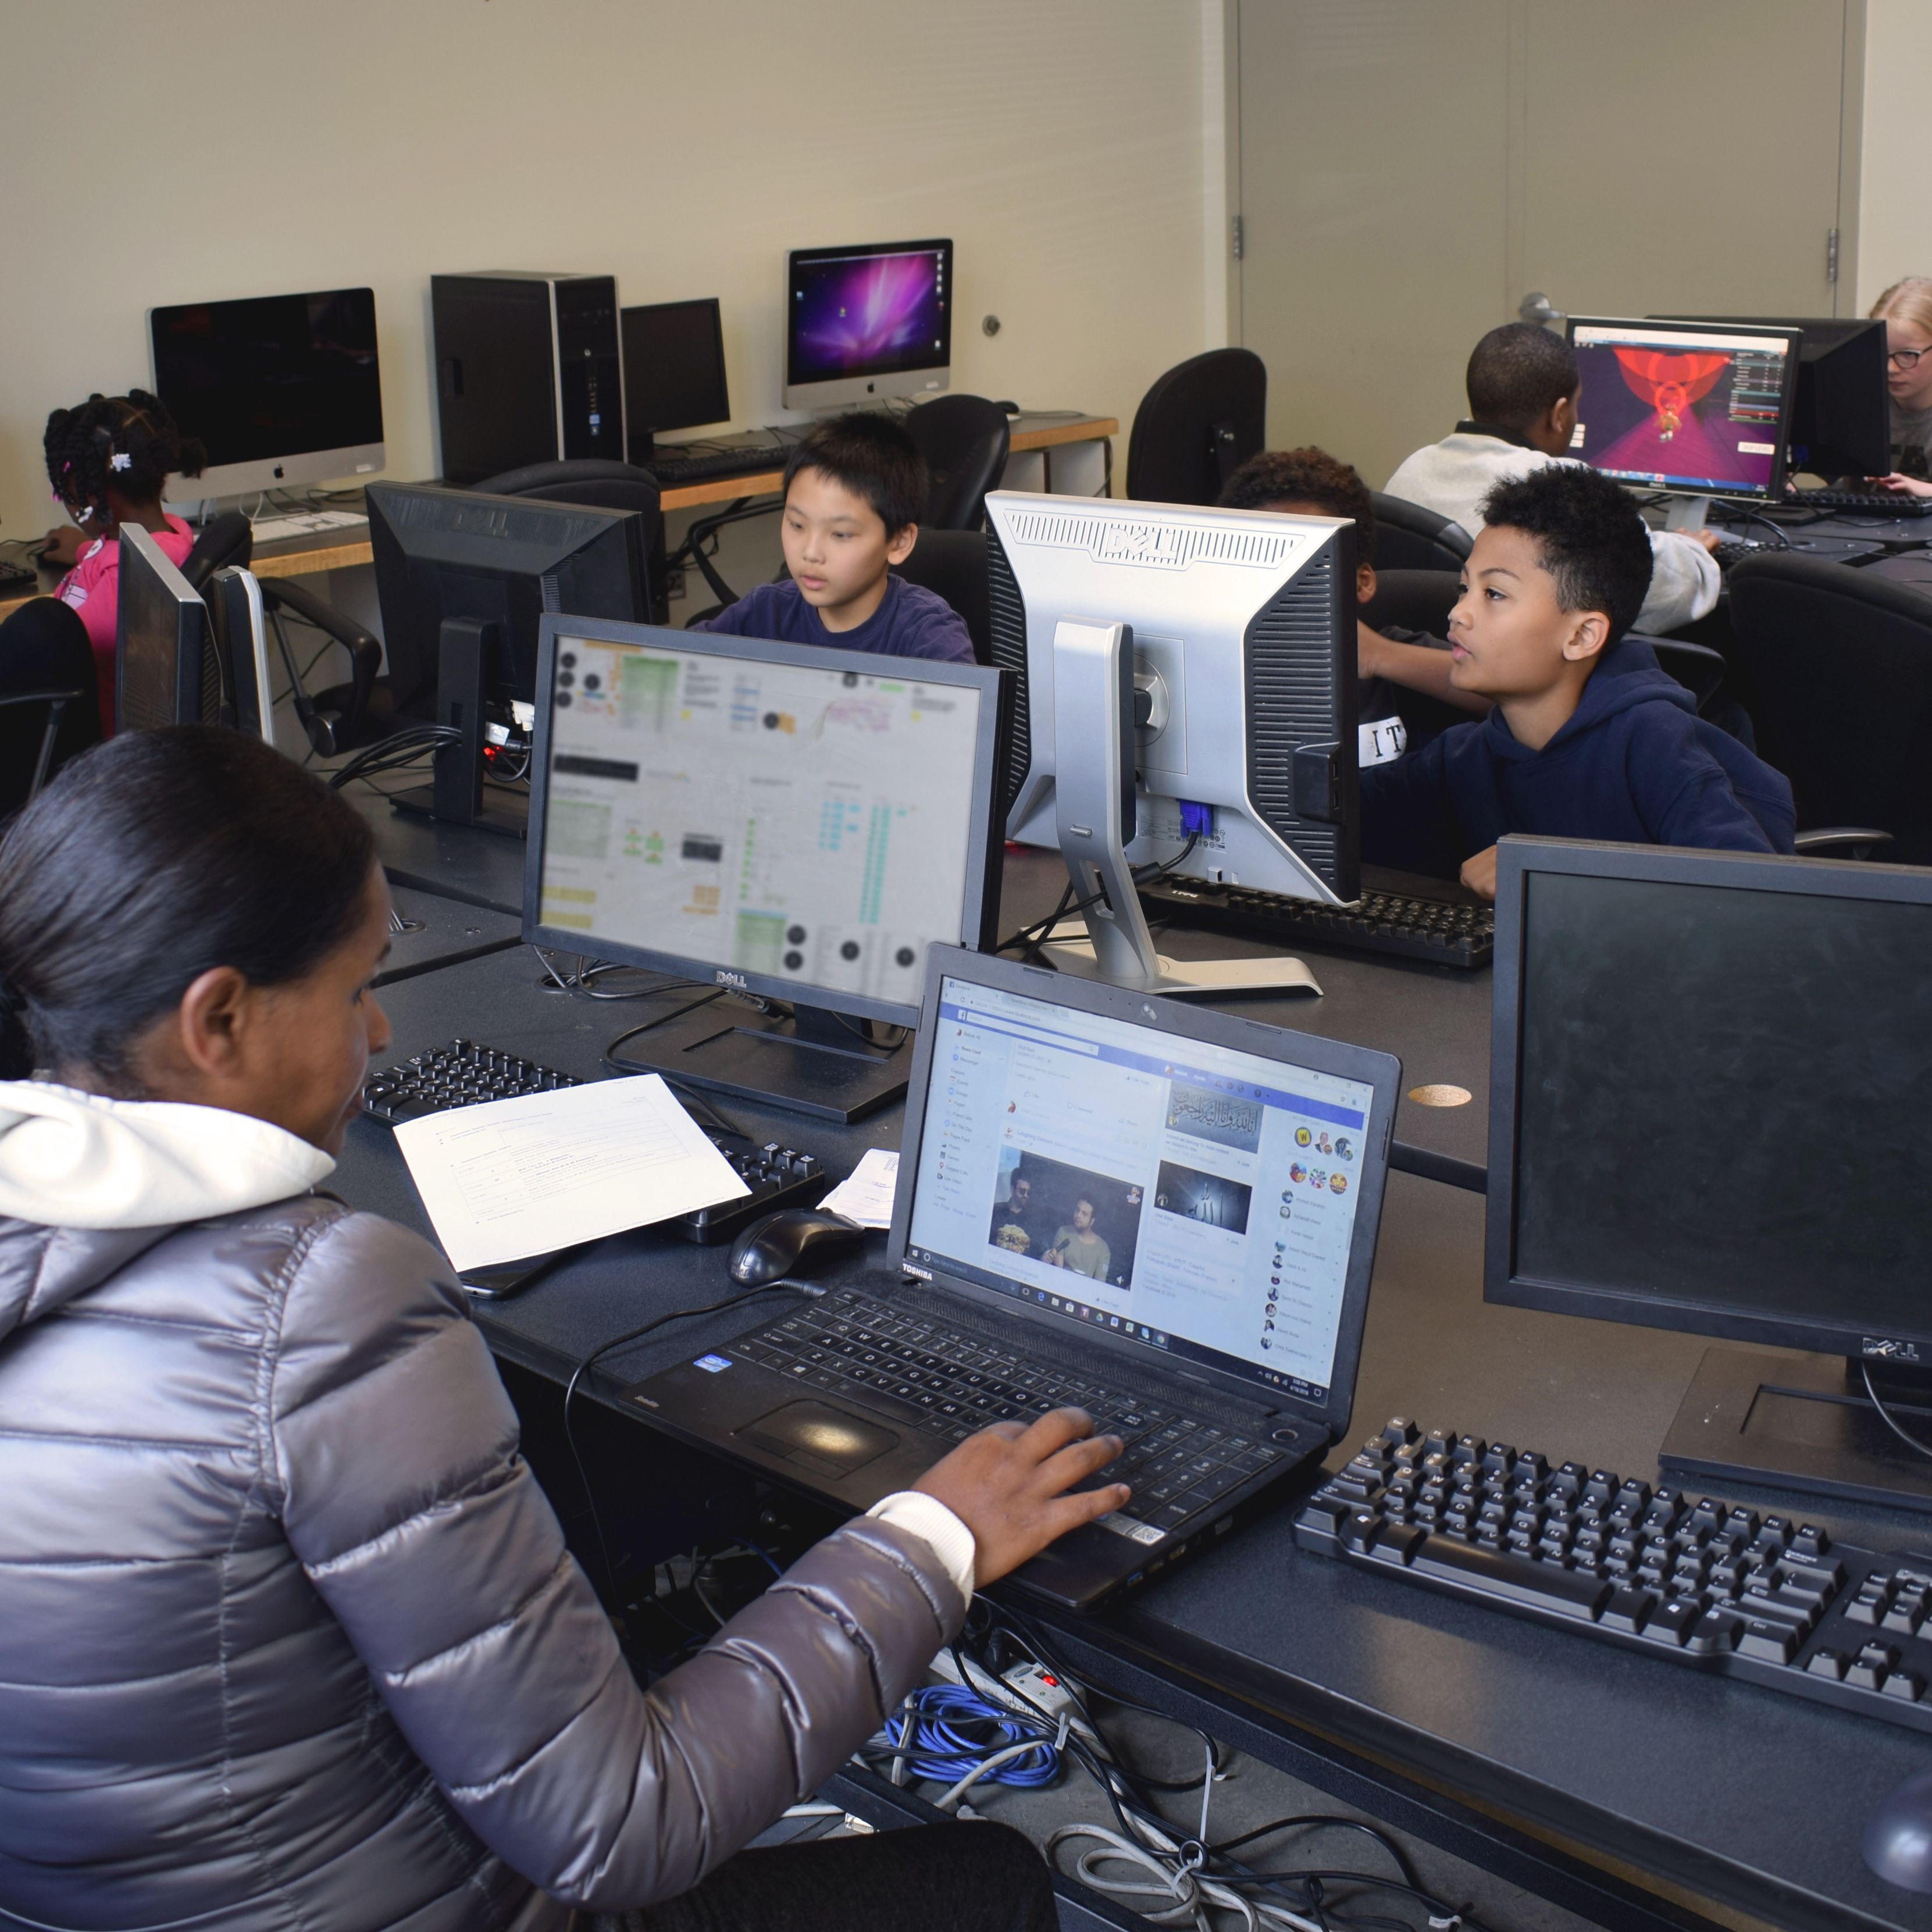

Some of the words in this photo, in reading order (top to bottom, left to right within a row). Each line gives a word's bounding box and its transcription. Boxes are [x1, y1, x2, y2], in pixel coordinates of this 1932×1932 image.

[1106, 527, 1177, 560] DELL
[716, 970, 747, 989] DELL
[971, 1047, 982, 1056] Feed
[959, 1056, 979, 1067] Messenger
[950, 1067, 965, 1076] Explore
[956, 1078, 969, 1088] Events
[954, 1089, 968, 1099] Groups
[953, 1100, 965, 1109] Pages
[949, 1132, 961, 1141] Pages
[1016, 1129, 1036, 1141] Laughing
[1300, 1133, 1307, 1142] W
[948, 1142, 961, 1152] Photos
[946, 1153, 960, 1163] Games
[903, 1263, 932, 1281] TOSHIBA
[1862, 1337, 1919, 1361] DELL
